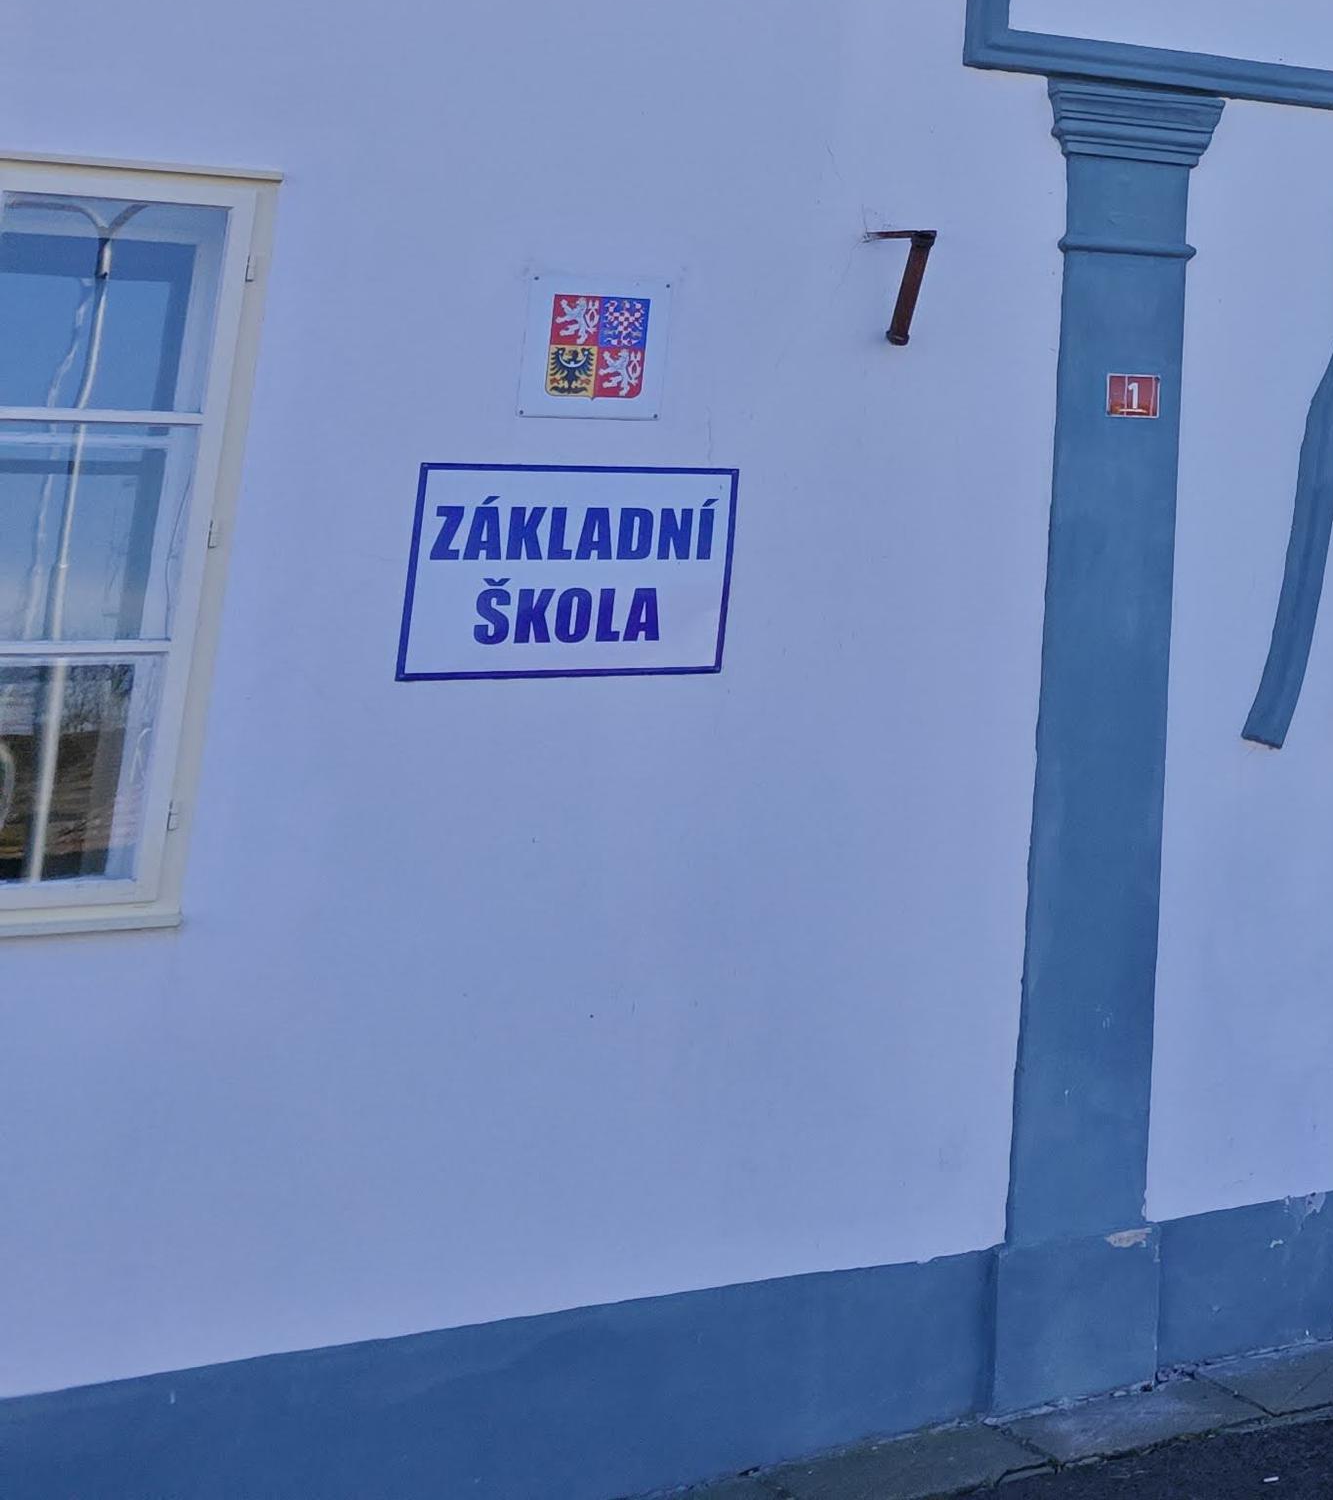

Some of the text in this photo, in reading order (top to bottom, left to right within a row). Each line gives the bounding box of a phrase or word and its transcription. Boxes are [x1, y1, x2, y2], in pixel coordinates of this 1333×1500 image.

[1127, 382, 1139, 409] 1
[429, 495, 720, 561] ZÁKLADNÍ
[473, 578, 660, 645] ŠKOLA
